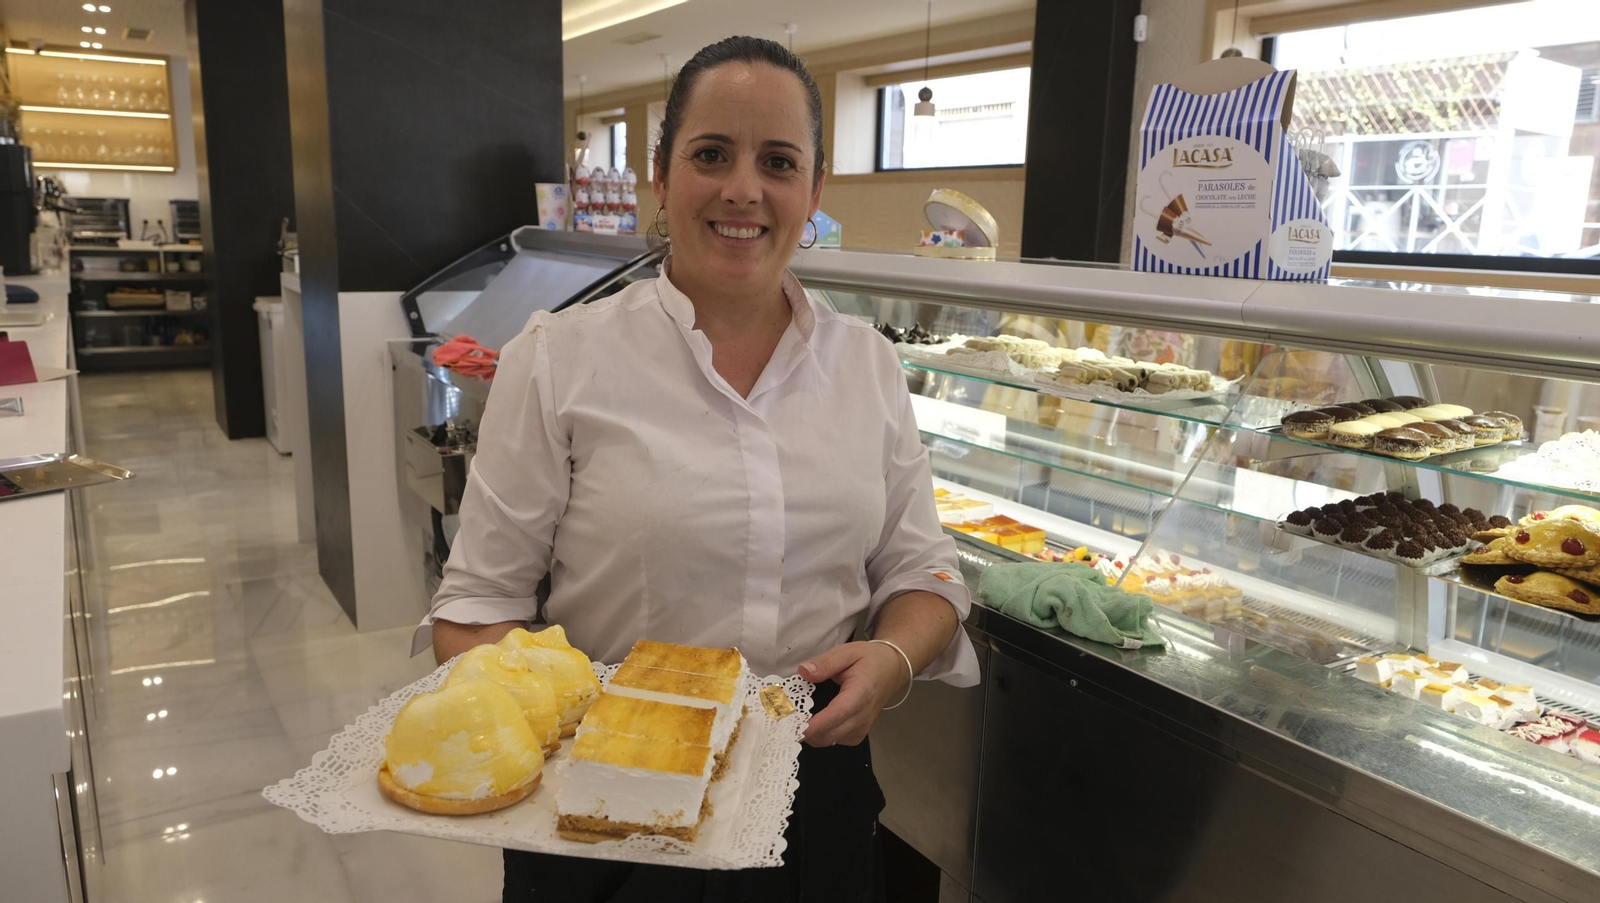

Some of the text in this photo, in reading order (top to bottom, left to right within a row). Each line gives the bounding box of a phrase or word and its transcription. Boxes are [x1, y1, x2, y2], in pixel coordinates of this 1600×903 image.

[1172, 147, 1233, 169] LACASA
[1198, 182, 1246, 191] PARASOLES
[1288, 227, 1320, 244] LACASA
